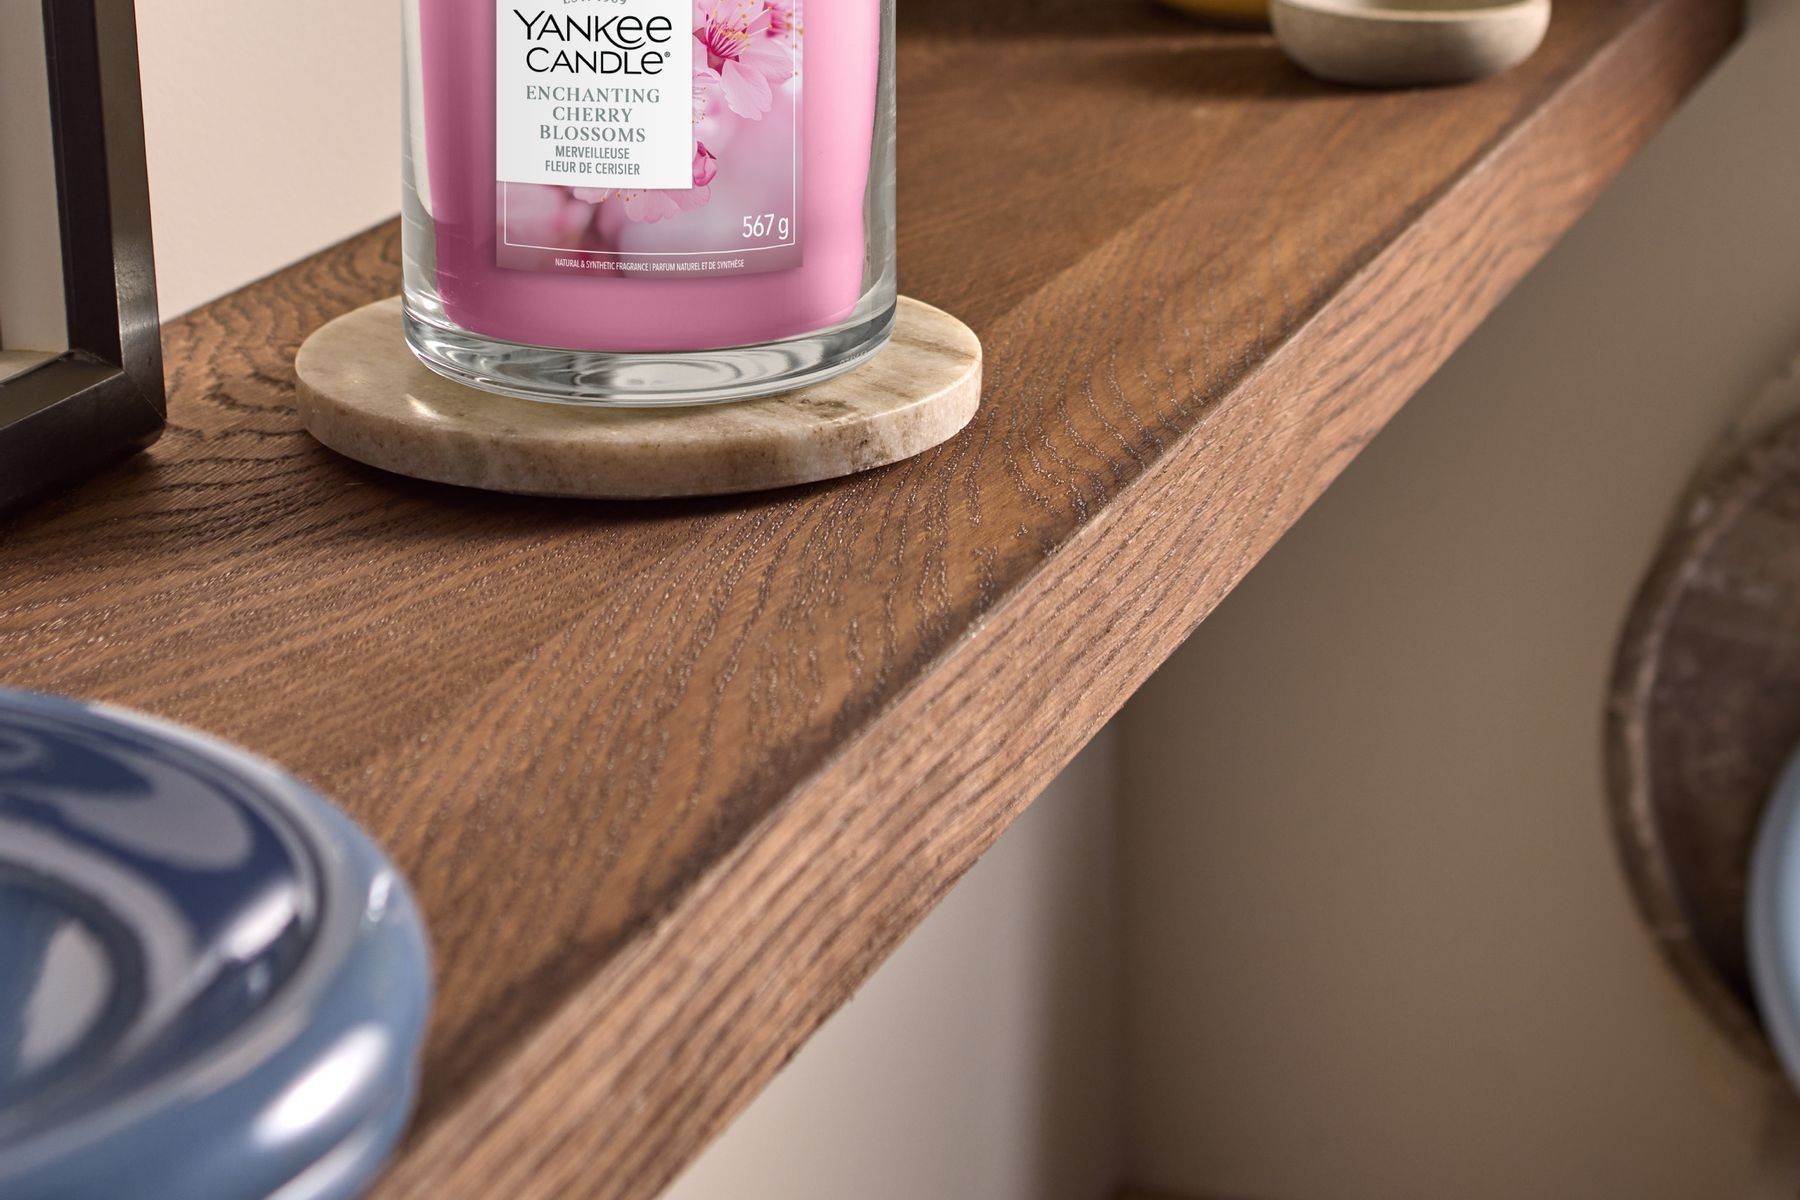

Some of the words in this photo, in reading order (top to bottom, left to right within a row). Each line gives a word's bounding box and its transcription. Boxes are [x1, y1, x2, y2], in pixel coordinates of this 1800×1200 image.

[526, 85, 661, 104] ENCHANTING
[552, 106, 633, 123] CHERRY
[540, 124, 646, 143] BLOSSOMS
[555, 145, 630, 160] MERVEILLEUSE
[545, 160, 576, 174] FLEUR
[579, 162, 593, 174] DE
[595, 163, 640, 176] CERISIER
[742, 213, 775, 238] 567
[778, 217, 789, 240] g
[555, 258, 580, 268] NATURAL
[580, 260, 586, 269] &
[586, 260, 615, 270] SYNTHETIC
[616, 262, 649, 272] FRAGRANCE
[652, 262, 676, 272] PARFUM
[676, 262, 701, 272] NATUREL
[701, 261, 708, 270] ET
[708, 261, 716, 270] DE
